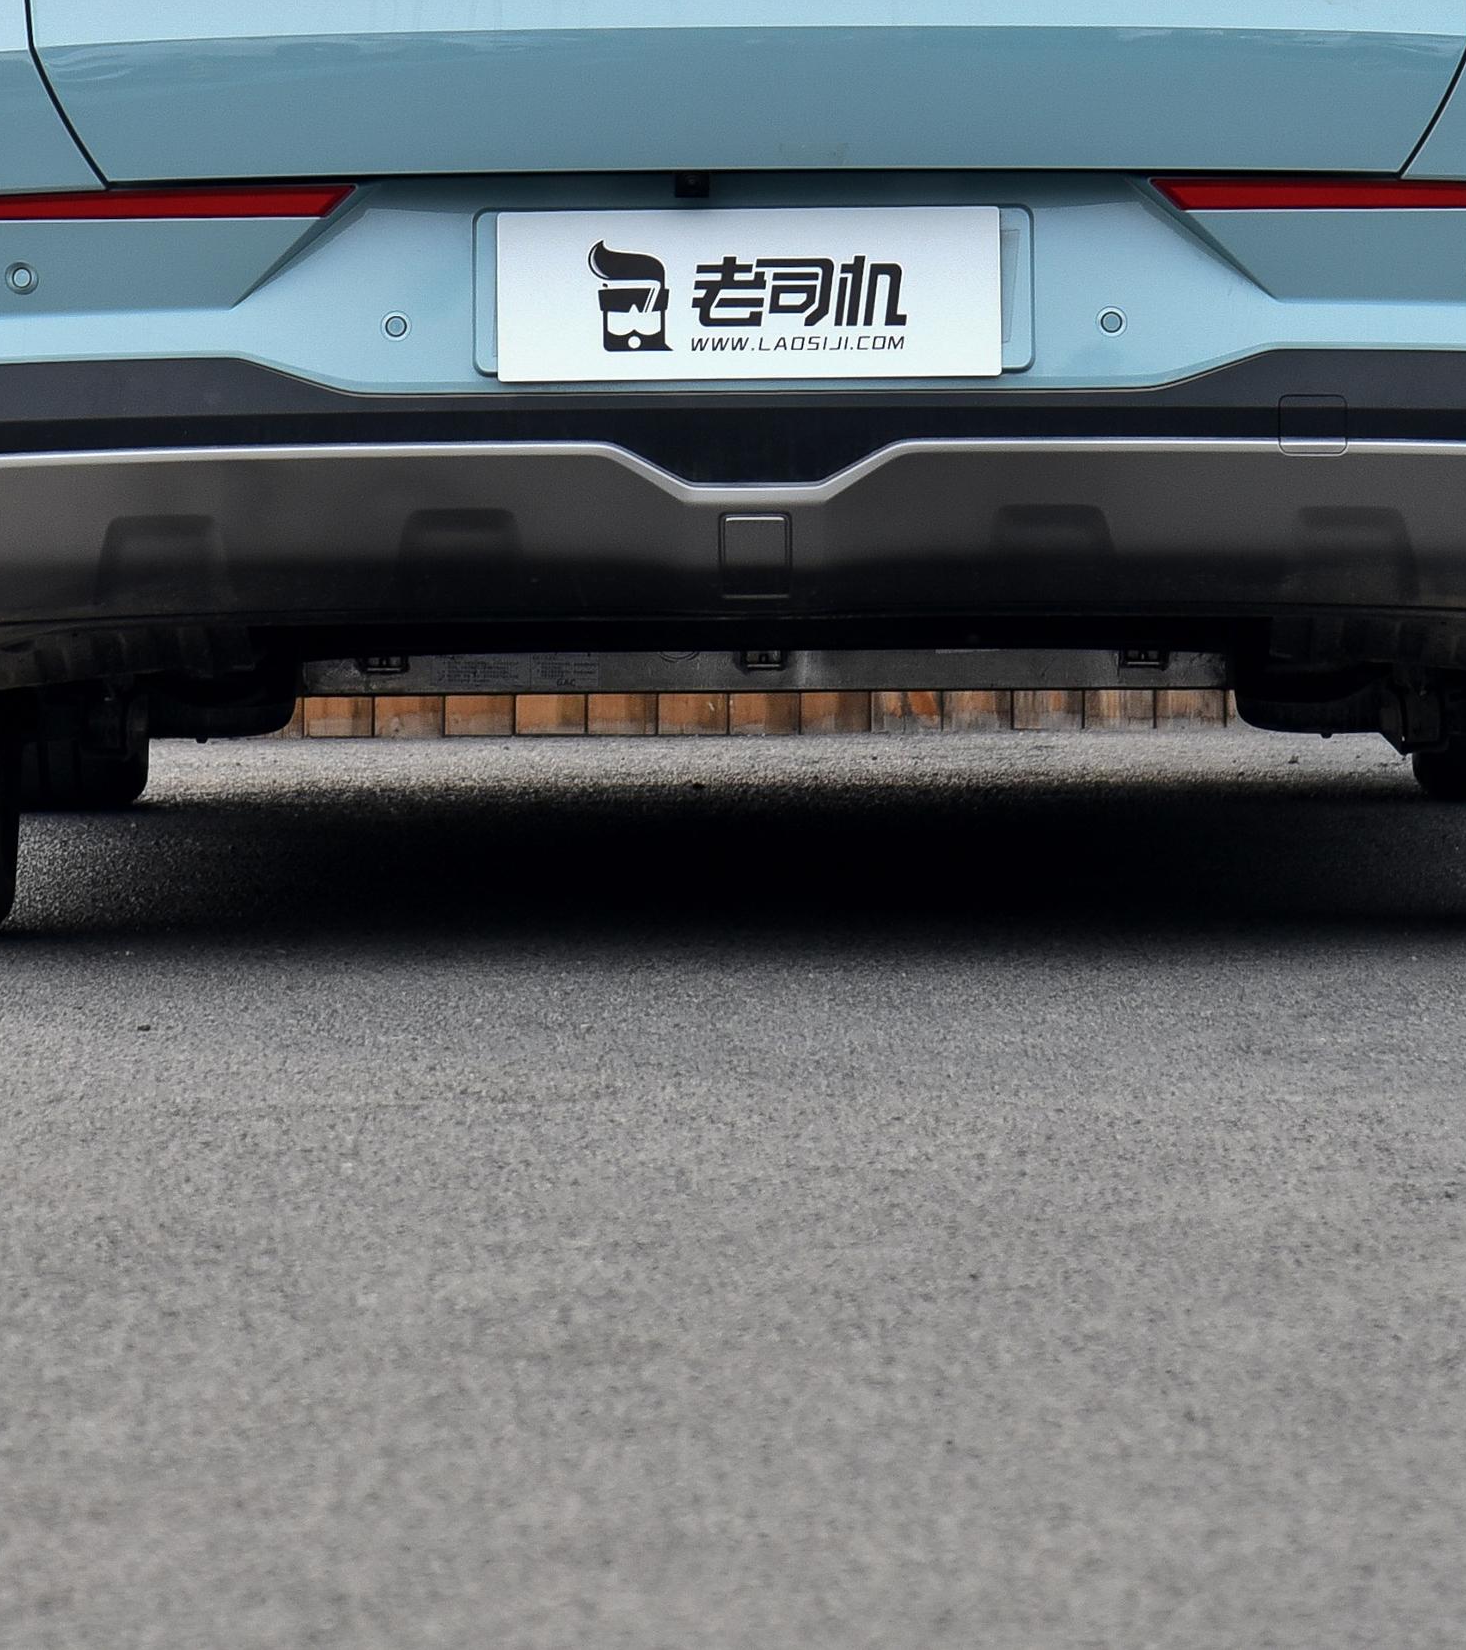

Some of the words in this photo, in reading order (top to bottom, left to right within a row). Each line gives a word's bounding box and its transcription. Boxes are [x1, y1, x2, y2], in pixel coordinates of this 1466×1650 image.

[691, 254, 907, 327] 老司机
[690, 335, 906, 351] WWW.LAOSIJI.COM
